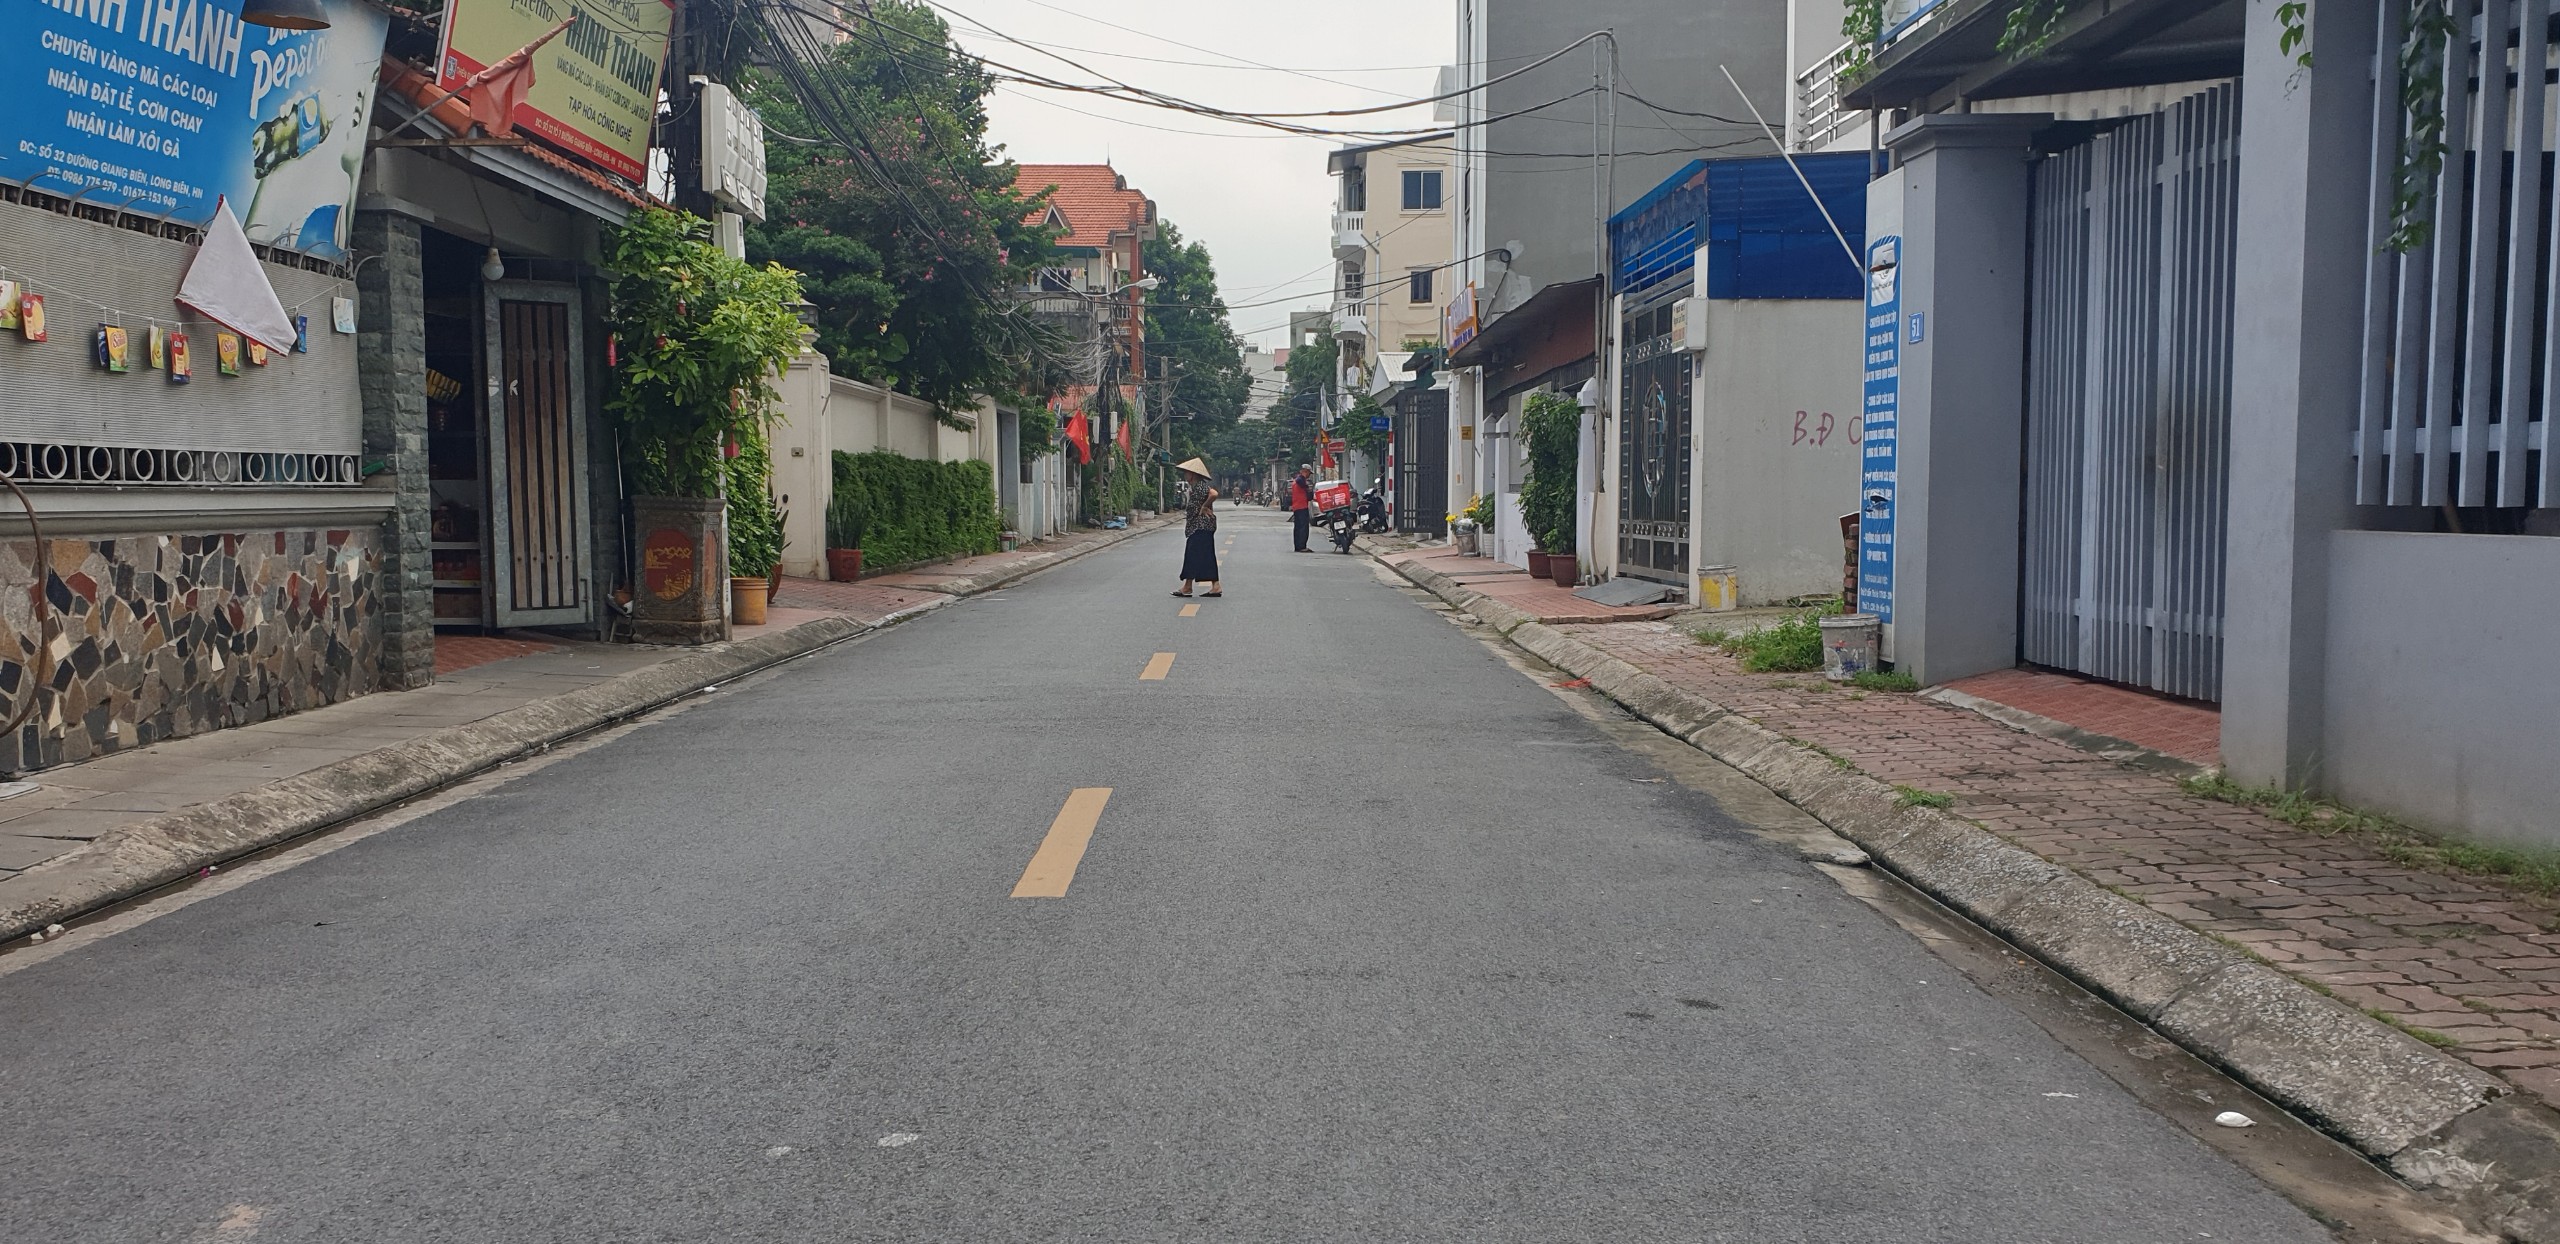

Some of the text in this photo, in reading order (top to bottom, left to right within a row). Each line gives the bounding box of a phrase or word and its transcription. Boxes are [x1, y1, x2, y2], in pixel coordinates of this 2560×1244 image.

[41, 30, 218, 111] CHUYÊN VÀNG MÃ CÁC LOẠI
[249, 34, 315, 120] Pepsi
[565, 4, 656, 98] MINH THANH
[47, 68, 203, 134] NHẬN ĐẶT LỄ, CƠM CHAY
[568, 95, 633, 145] TẠP HÓA CÔNG NGHỆ
[66, 109, 180, 159] NHẬN LÀM XÔI GÀ
[19, 139, 204, 199] ĐC: SỐ 32 ĐƯỜNG GIANG BIÊN, LONG BIÊN, HN
[62, 169, 84, 186] 0986
[147, 190, 162, 204] 153
[1911, 317, 1920, 338] 51
